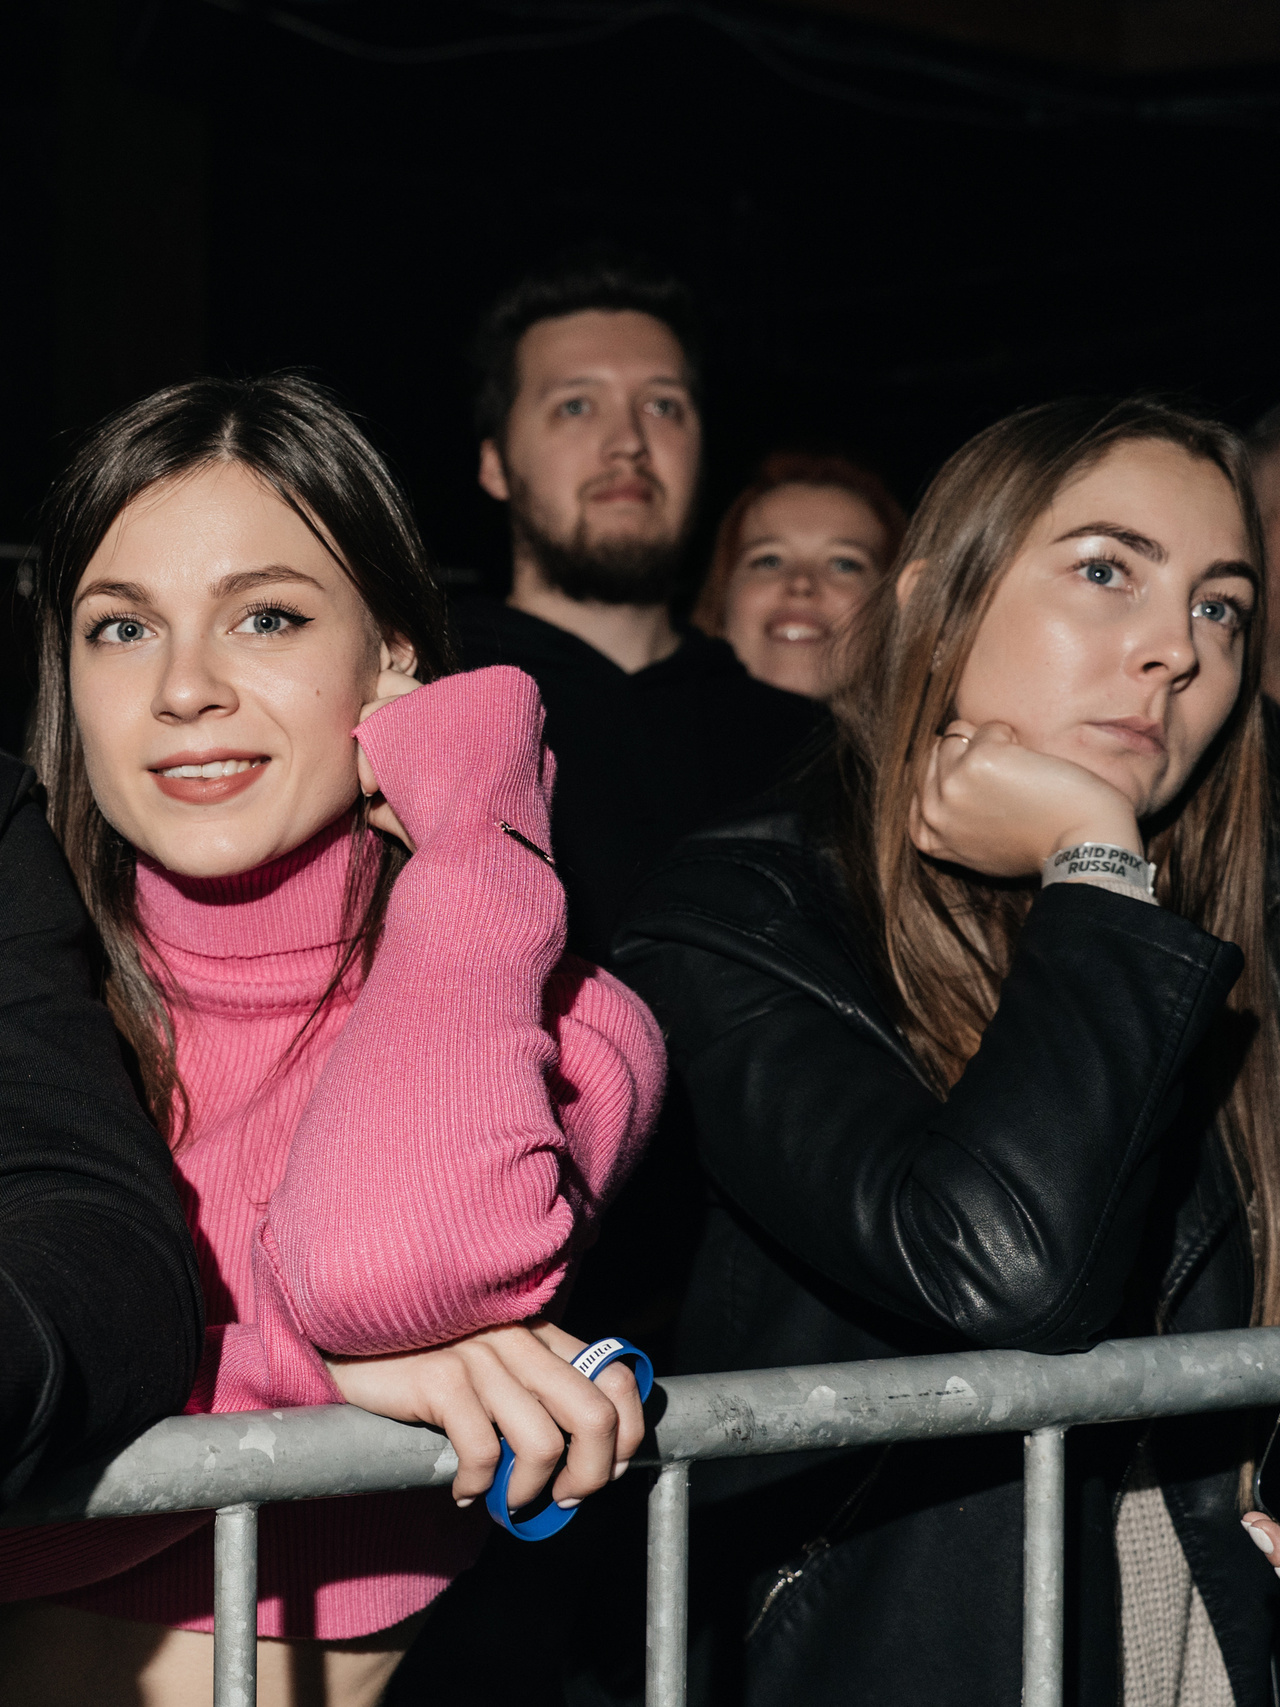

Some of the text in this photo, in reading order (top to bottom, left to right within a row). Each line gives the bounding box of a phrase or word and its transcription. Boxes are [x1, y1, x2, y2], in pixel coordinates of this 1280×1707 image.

[1054, 847, 1142, 871] GRAND PRIX
[1068, 860, 1126, 877] RUSSIA
